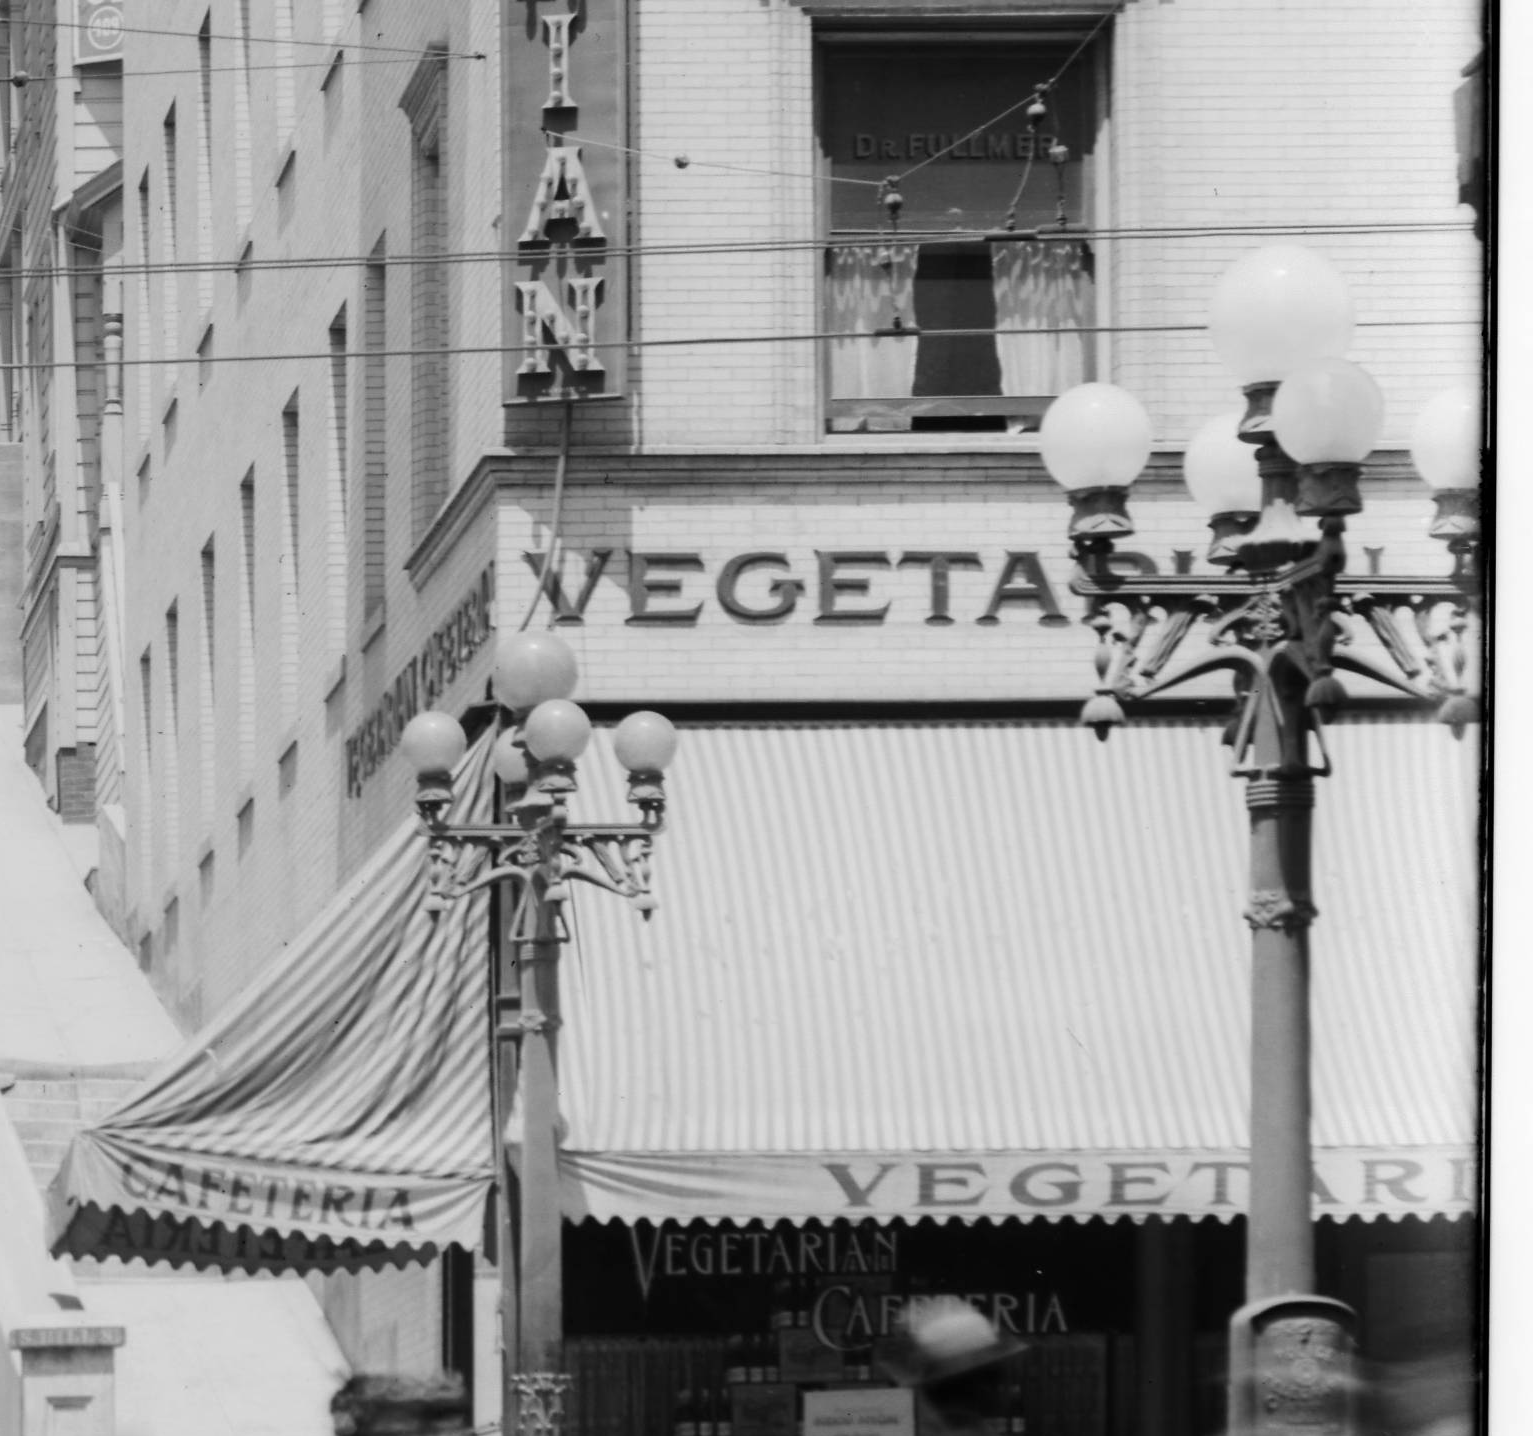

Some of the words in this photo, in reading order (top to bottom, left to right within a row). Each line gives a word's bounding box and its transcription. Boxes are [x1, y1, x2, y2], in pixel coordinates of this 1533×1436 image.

[908, 132, 1058, 161] FULLMER
[525, 550, 1386, 627] VEGETA
[120, 1160, 417, 1233] CAFETERIA
[629, 1224, 900, 1301] VEGETARIAN
